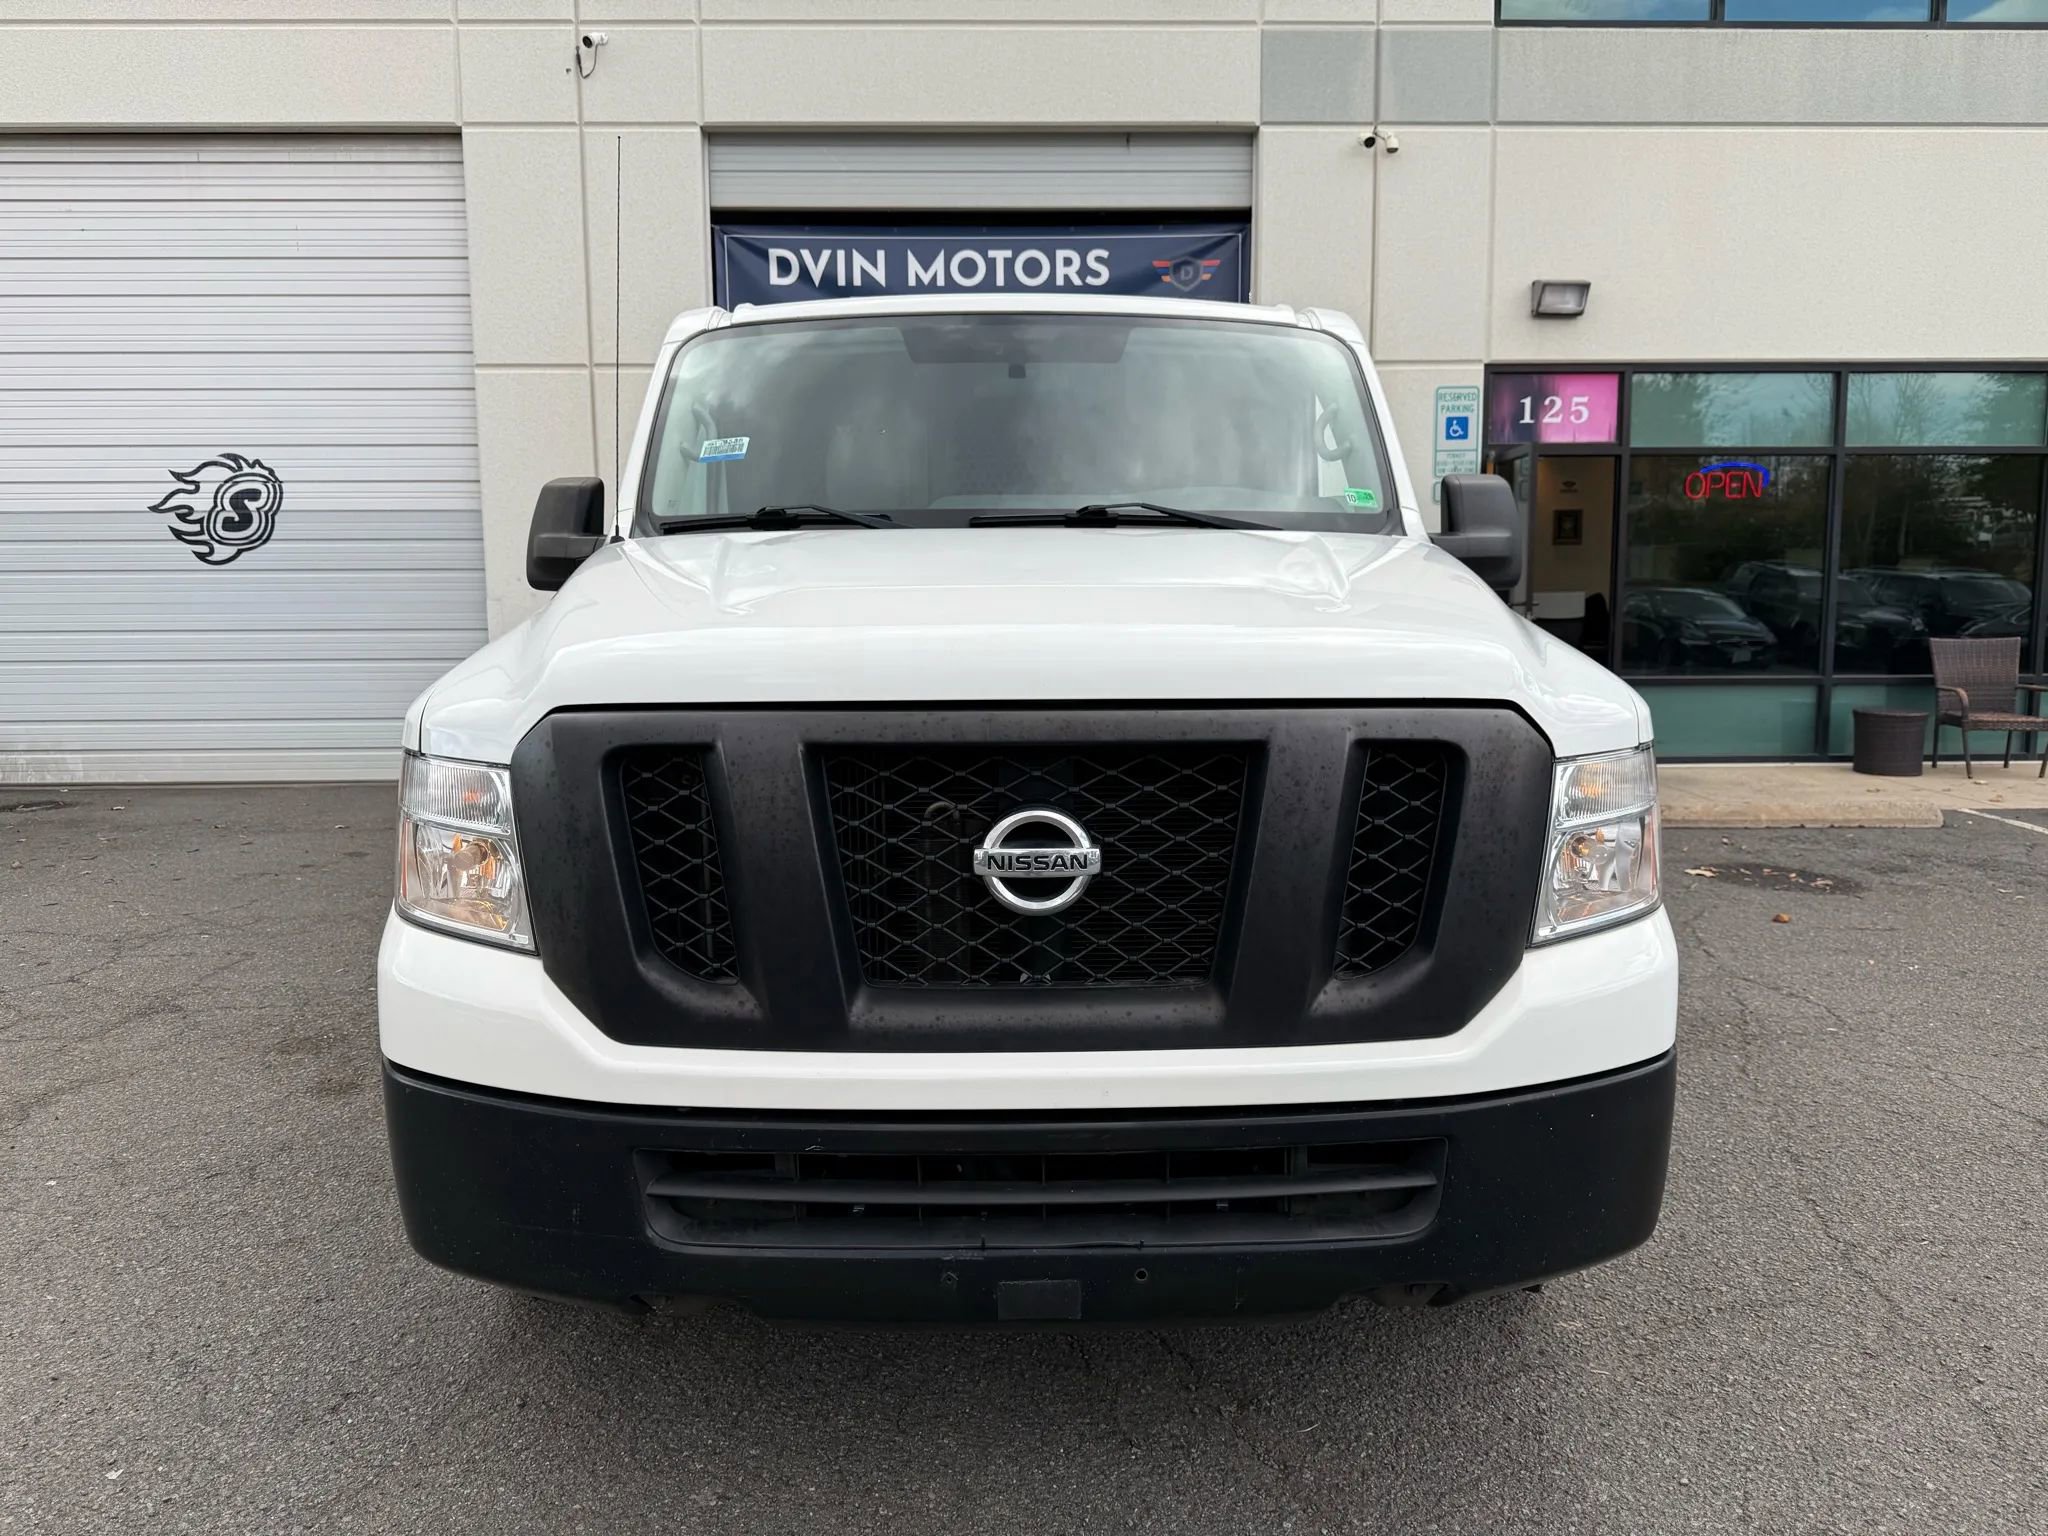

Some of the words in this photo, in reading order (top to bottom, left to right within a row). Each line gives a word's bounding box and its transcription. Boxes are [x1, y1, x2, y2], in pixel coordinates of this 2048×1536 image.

[768, 248, 886, 288] DVIN
[907, 248, 1110, 288] MOTORS
[1181, 266, 1193, 280] D
[1438, 391, 1477, 403] RESERVED
[1440, 404, 1475, 414] PARKING
[1519, 395, 1590, 424] 125
[1684, 470, 1763, 500] OPEN
[1346, 493, 1357, 503] 10
[987, 854, 1088, 871] NISSAN
